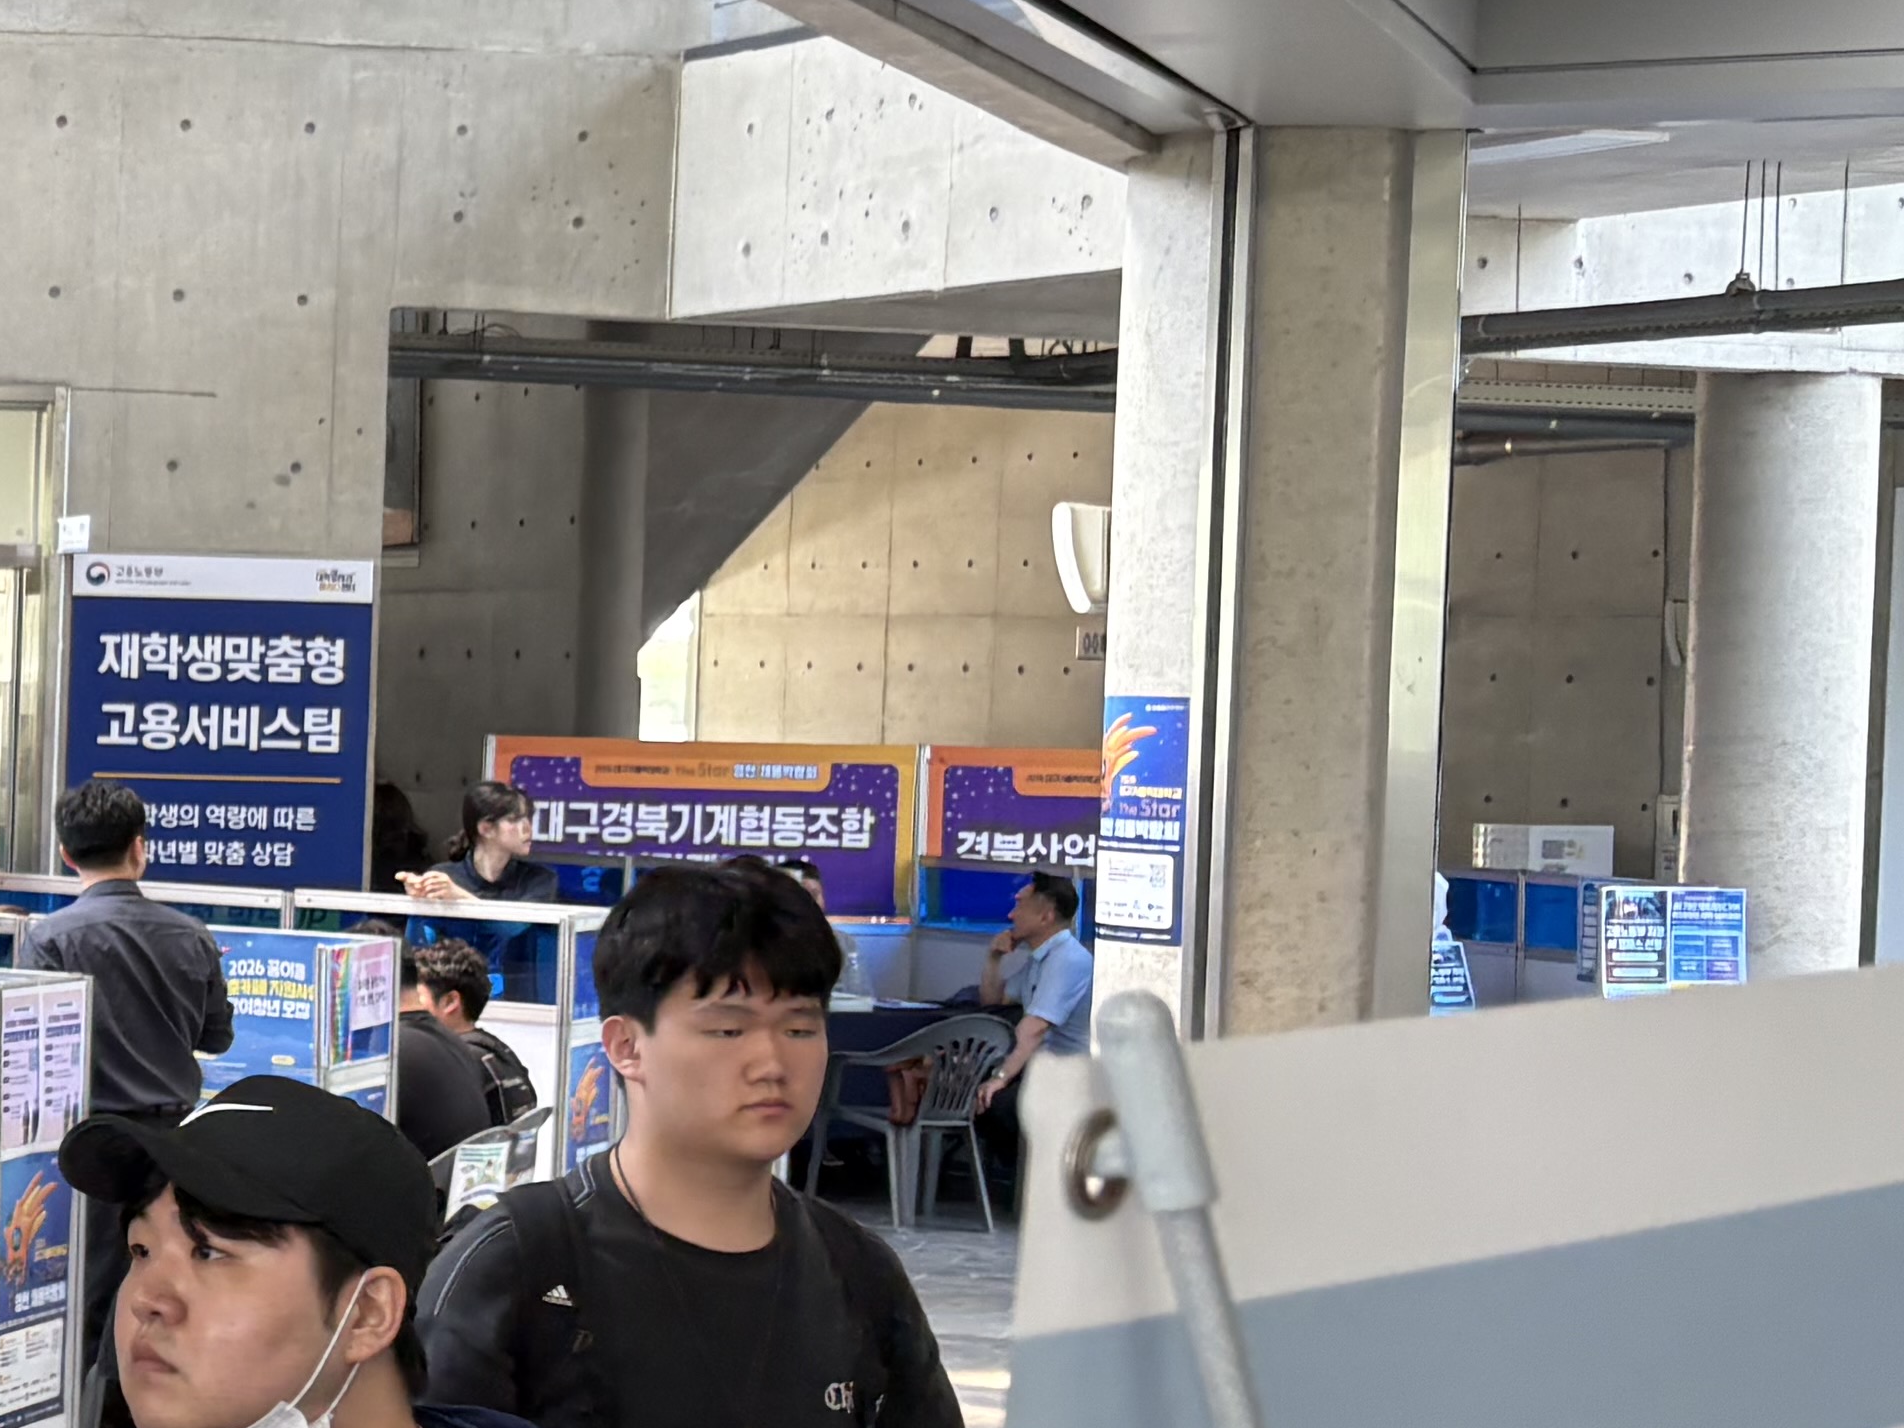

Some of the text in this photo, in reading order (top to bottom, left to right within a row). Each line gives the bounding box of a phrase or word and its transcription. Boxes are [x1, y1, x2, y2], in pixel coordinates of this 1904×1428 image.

[96, 631, 347, 686] 재학생맞춤형
[96, 702, 342, 754] 고용서비스팀
[205, 803, 268, 831] 역량에
[273, 806, 317, 833] 따른
[1139, 798, 1181, 819] Star
[531, 799, 876, 850] 대구경북기계협동조합
[204, 840, 245, 867] 맞춤
[251, 843, 295, 868] 상담
[228, 958, 266, 977] 2026
